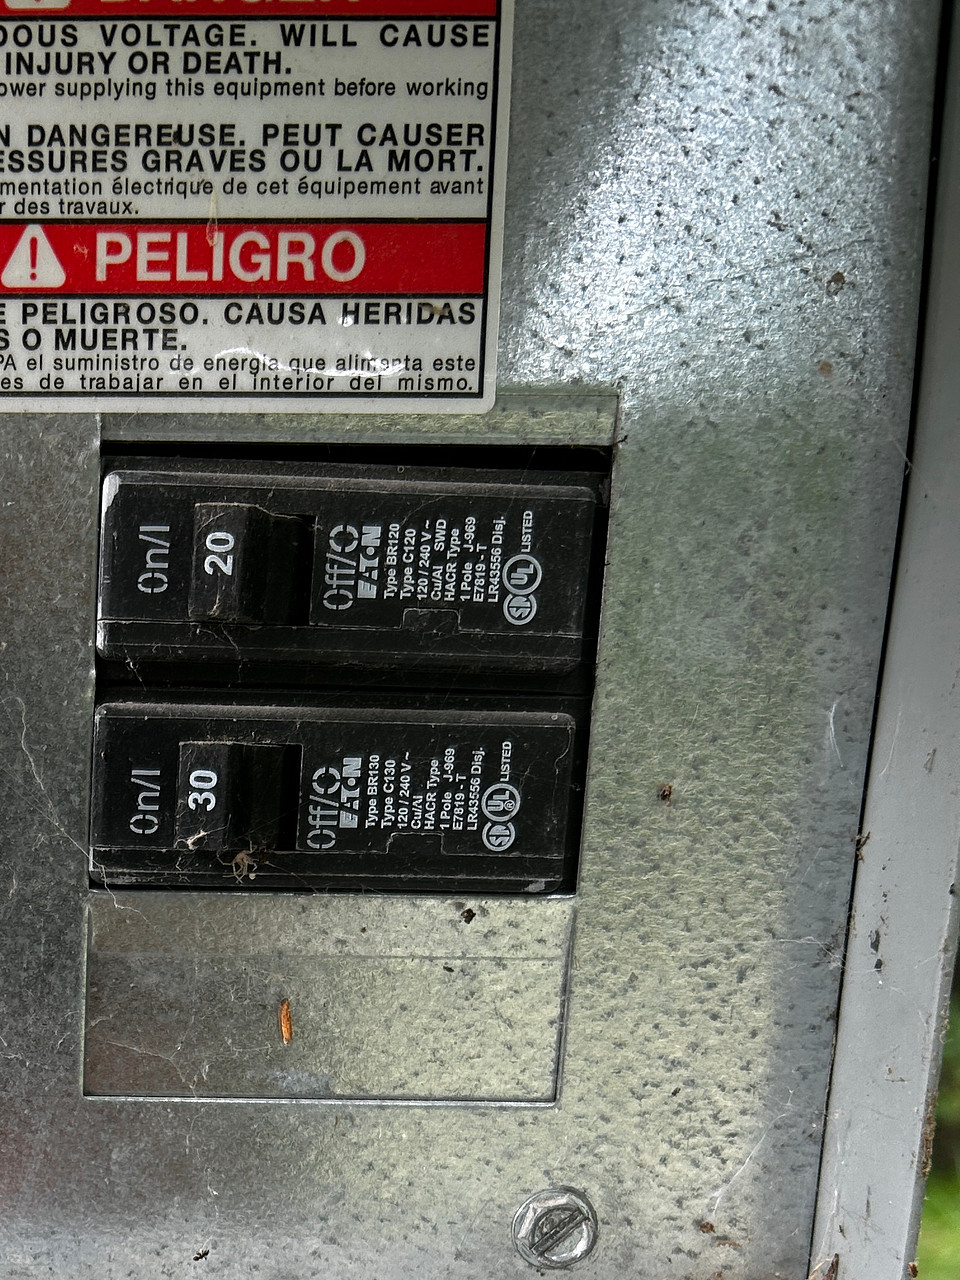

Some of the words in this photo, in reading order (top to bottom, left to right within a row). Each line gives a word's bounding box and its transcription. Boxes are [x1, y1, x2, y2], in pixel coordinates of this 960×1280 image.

[100, 24, 256, 47] VOLTAGE.
[280, 24, 357, 46] WILL
[380, 24, 489, 47] CAUSE
[6, 52, 116, 75] INJURY
[128, 51, 169, 74] OR
[183, 51, 291, 74] DEATH.
[55, 78, 156, 100] supplying
[166, 78, 204, 96] this
[214, 78, 325, 100] equipment
[335, 78, 395, 96] before
[407, 78, 488, 100] working
[28, 124, 245, 147] DANGEREUSE.
[263, 124, 342, 146] PEUT
[357, 123, 484, 146] CAUSER
[142, 149, 265, 172] GRAVES
[280, 149, 322, 172] OU
[337, 149, 373, 171] LA
[388, 149, 482, 172] MORT.
[112, 176, 213, 199] électrique
[223, 177, 247, 194] de
[257, 178, 288, 195] cet
[298, 176, 421, 199] équipement
[430, 178, 483, 194] avant
[14, 198, 49, 215] des
[59, 199, 138, 214] travaux.
[96, 230, 365, 282] PELIGRO
[22, 302, 207, 324] PELIGROSO.
[224, 302, 326, 325] CAUSA
[342, 302, 475, 324] HERIDAS
[22, 328, 41, 350] O
[55, 329, 186, 350] MUERTE.
[27, 354, 42, 370] el
[54, 354, 159, 371] suministro
[170, 354, 193, 371] de
[289, 358, 325, 377] que
[433, 355, 475, 371] este
[40, 373, 64, 389] de
[80, 374, 164, 393] trabajar
[179, 377, 202, 390] en
[219, 374, 236, 390] el
[254, 374, 334, 390] interior
[350, 375, 382, 390] del
[399, 374, 472, 390] mismo.
[385, 524, 399, 565] BR120
[403, 529, 416, 563] C120
[434, 519, 446, 551] SWD
[447, 529, 461, 559] Type
[521, 511, 532, 552] LISTED
[204, 532, 234, 575] 20
[357, 526, 381, 598] EATON
[384, 569, 397, 599] Type
[400, 567, 414, 599] Type
[444, 563, 456, 601] HACR
[367, 755, 379, 795] BR130
[383, 760, 396, 793] C130
[427, 760, 440, 789] Type
[500, 742, 511, 781] LISTED
[188, 770, 217, 811] 30
[340, 758, 362, 828] EATON
[365, 799, 378, 828] Type
[381, 797, 395, 828] Type
[424, 792, 436, 829] HACR
